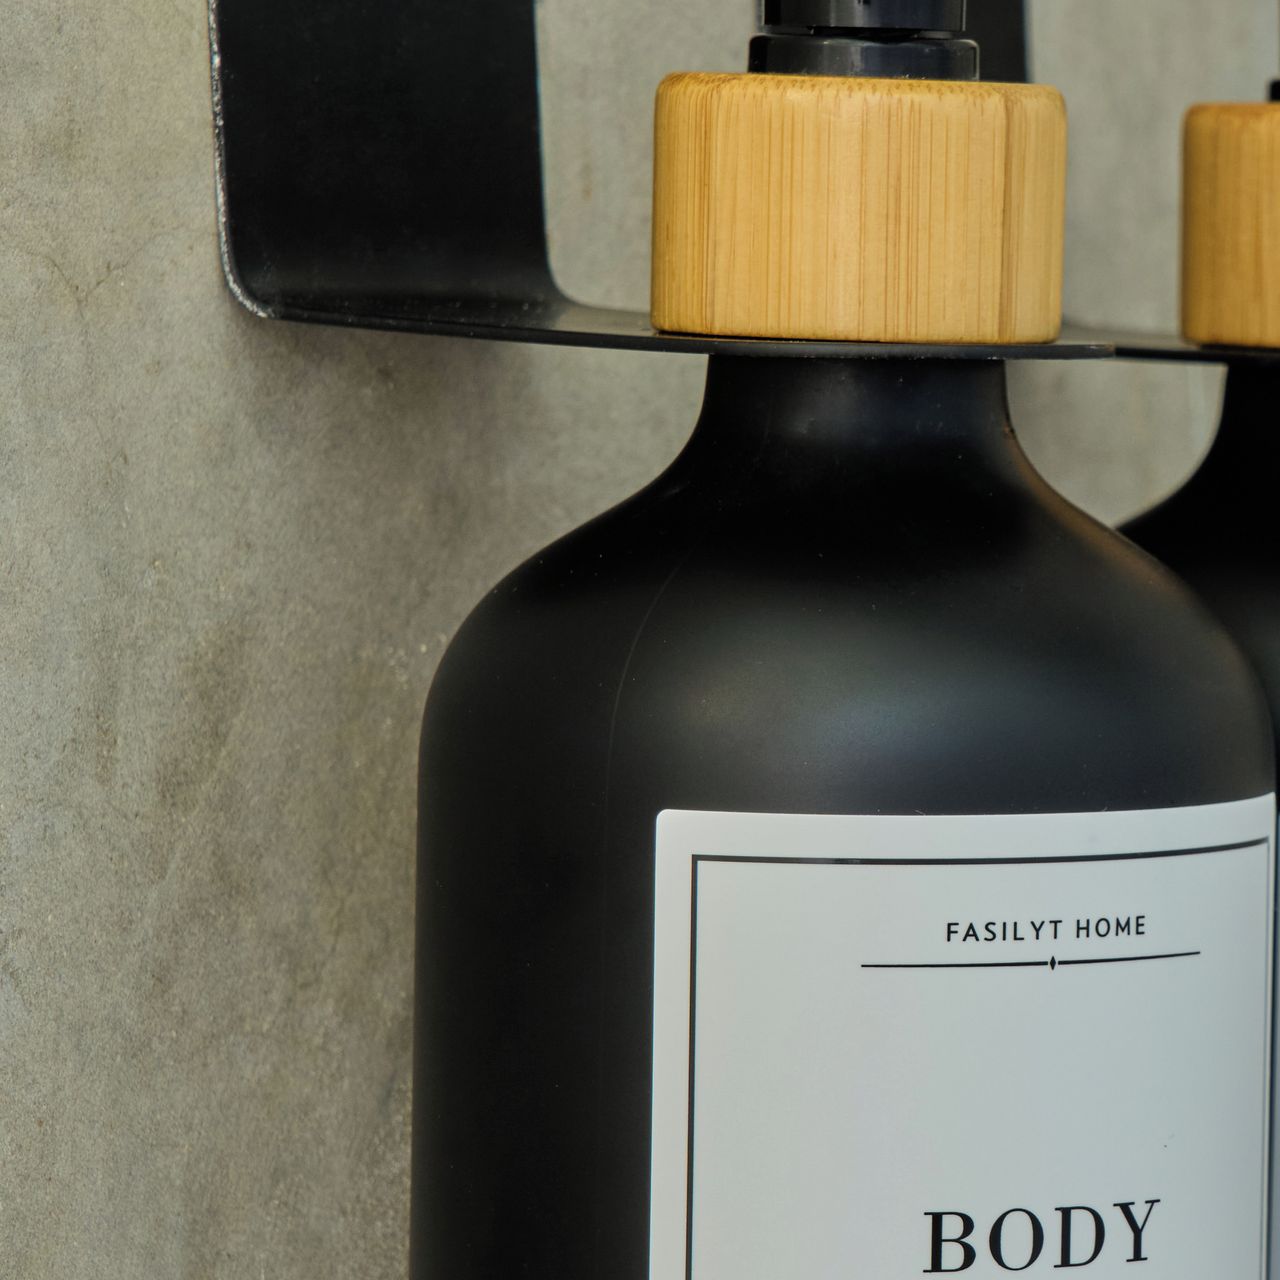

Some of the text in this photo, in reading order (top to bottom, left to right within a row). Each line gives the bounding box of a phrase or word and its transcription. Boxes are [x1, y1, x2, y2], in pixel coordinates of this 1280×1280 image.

[946, 914, 1147, 943] FASILYT HOME
[922, 1198, 1161, 1274] BODY
